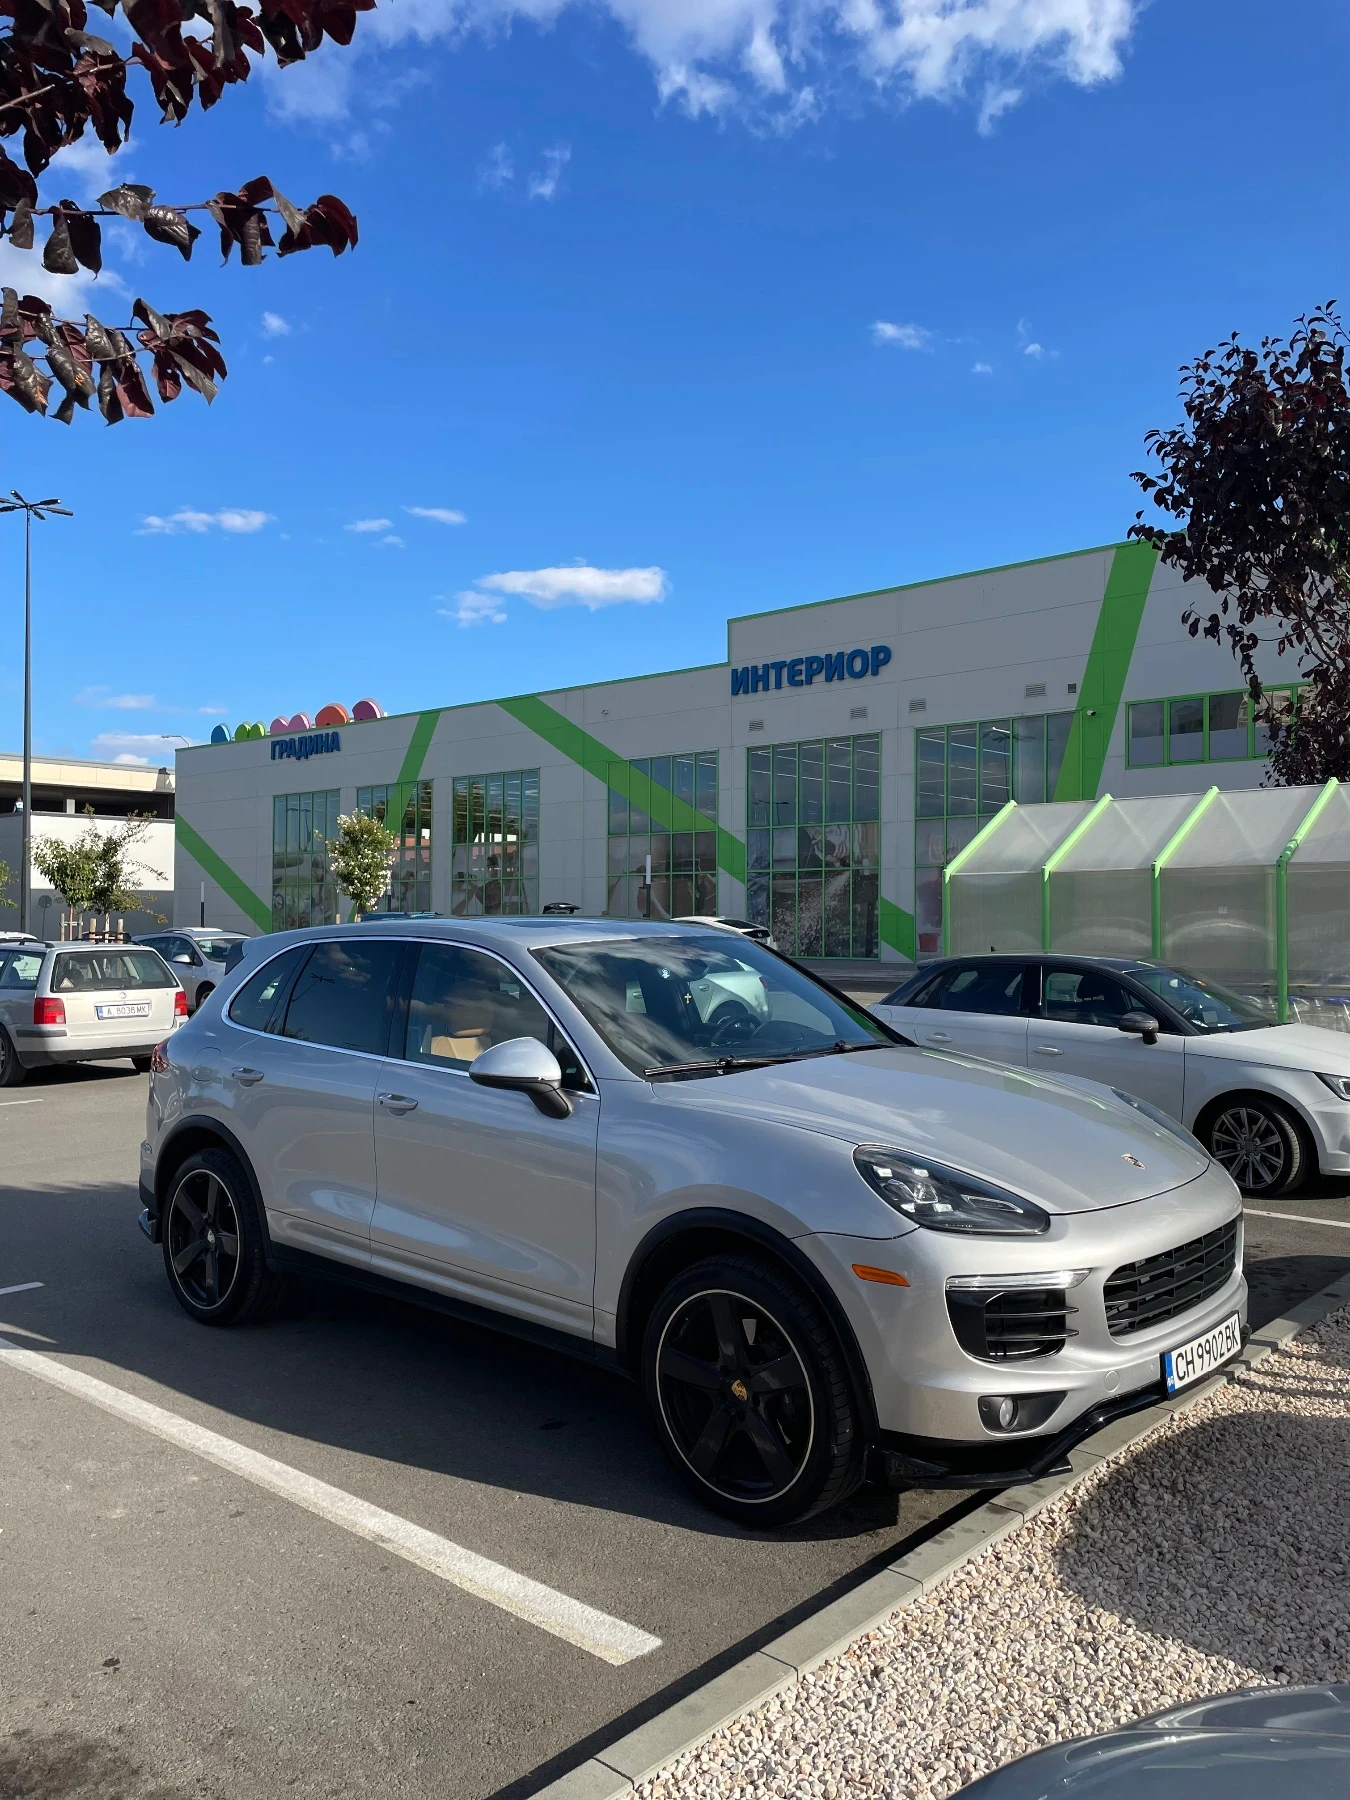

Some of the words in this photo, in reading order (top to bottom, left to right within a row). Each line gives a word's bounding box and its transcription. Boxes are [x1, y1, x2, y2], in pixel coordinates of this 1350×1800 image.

[731, 645, 892, 696] ИНТЕРИОР
[270, 731, 341, 761] ГРАДИНА
[1175, 1345, 1196, 1382] CH
[1196, 1330, 1226, 1371] 9902
[1224, 1318, 1239, 1353] BK
